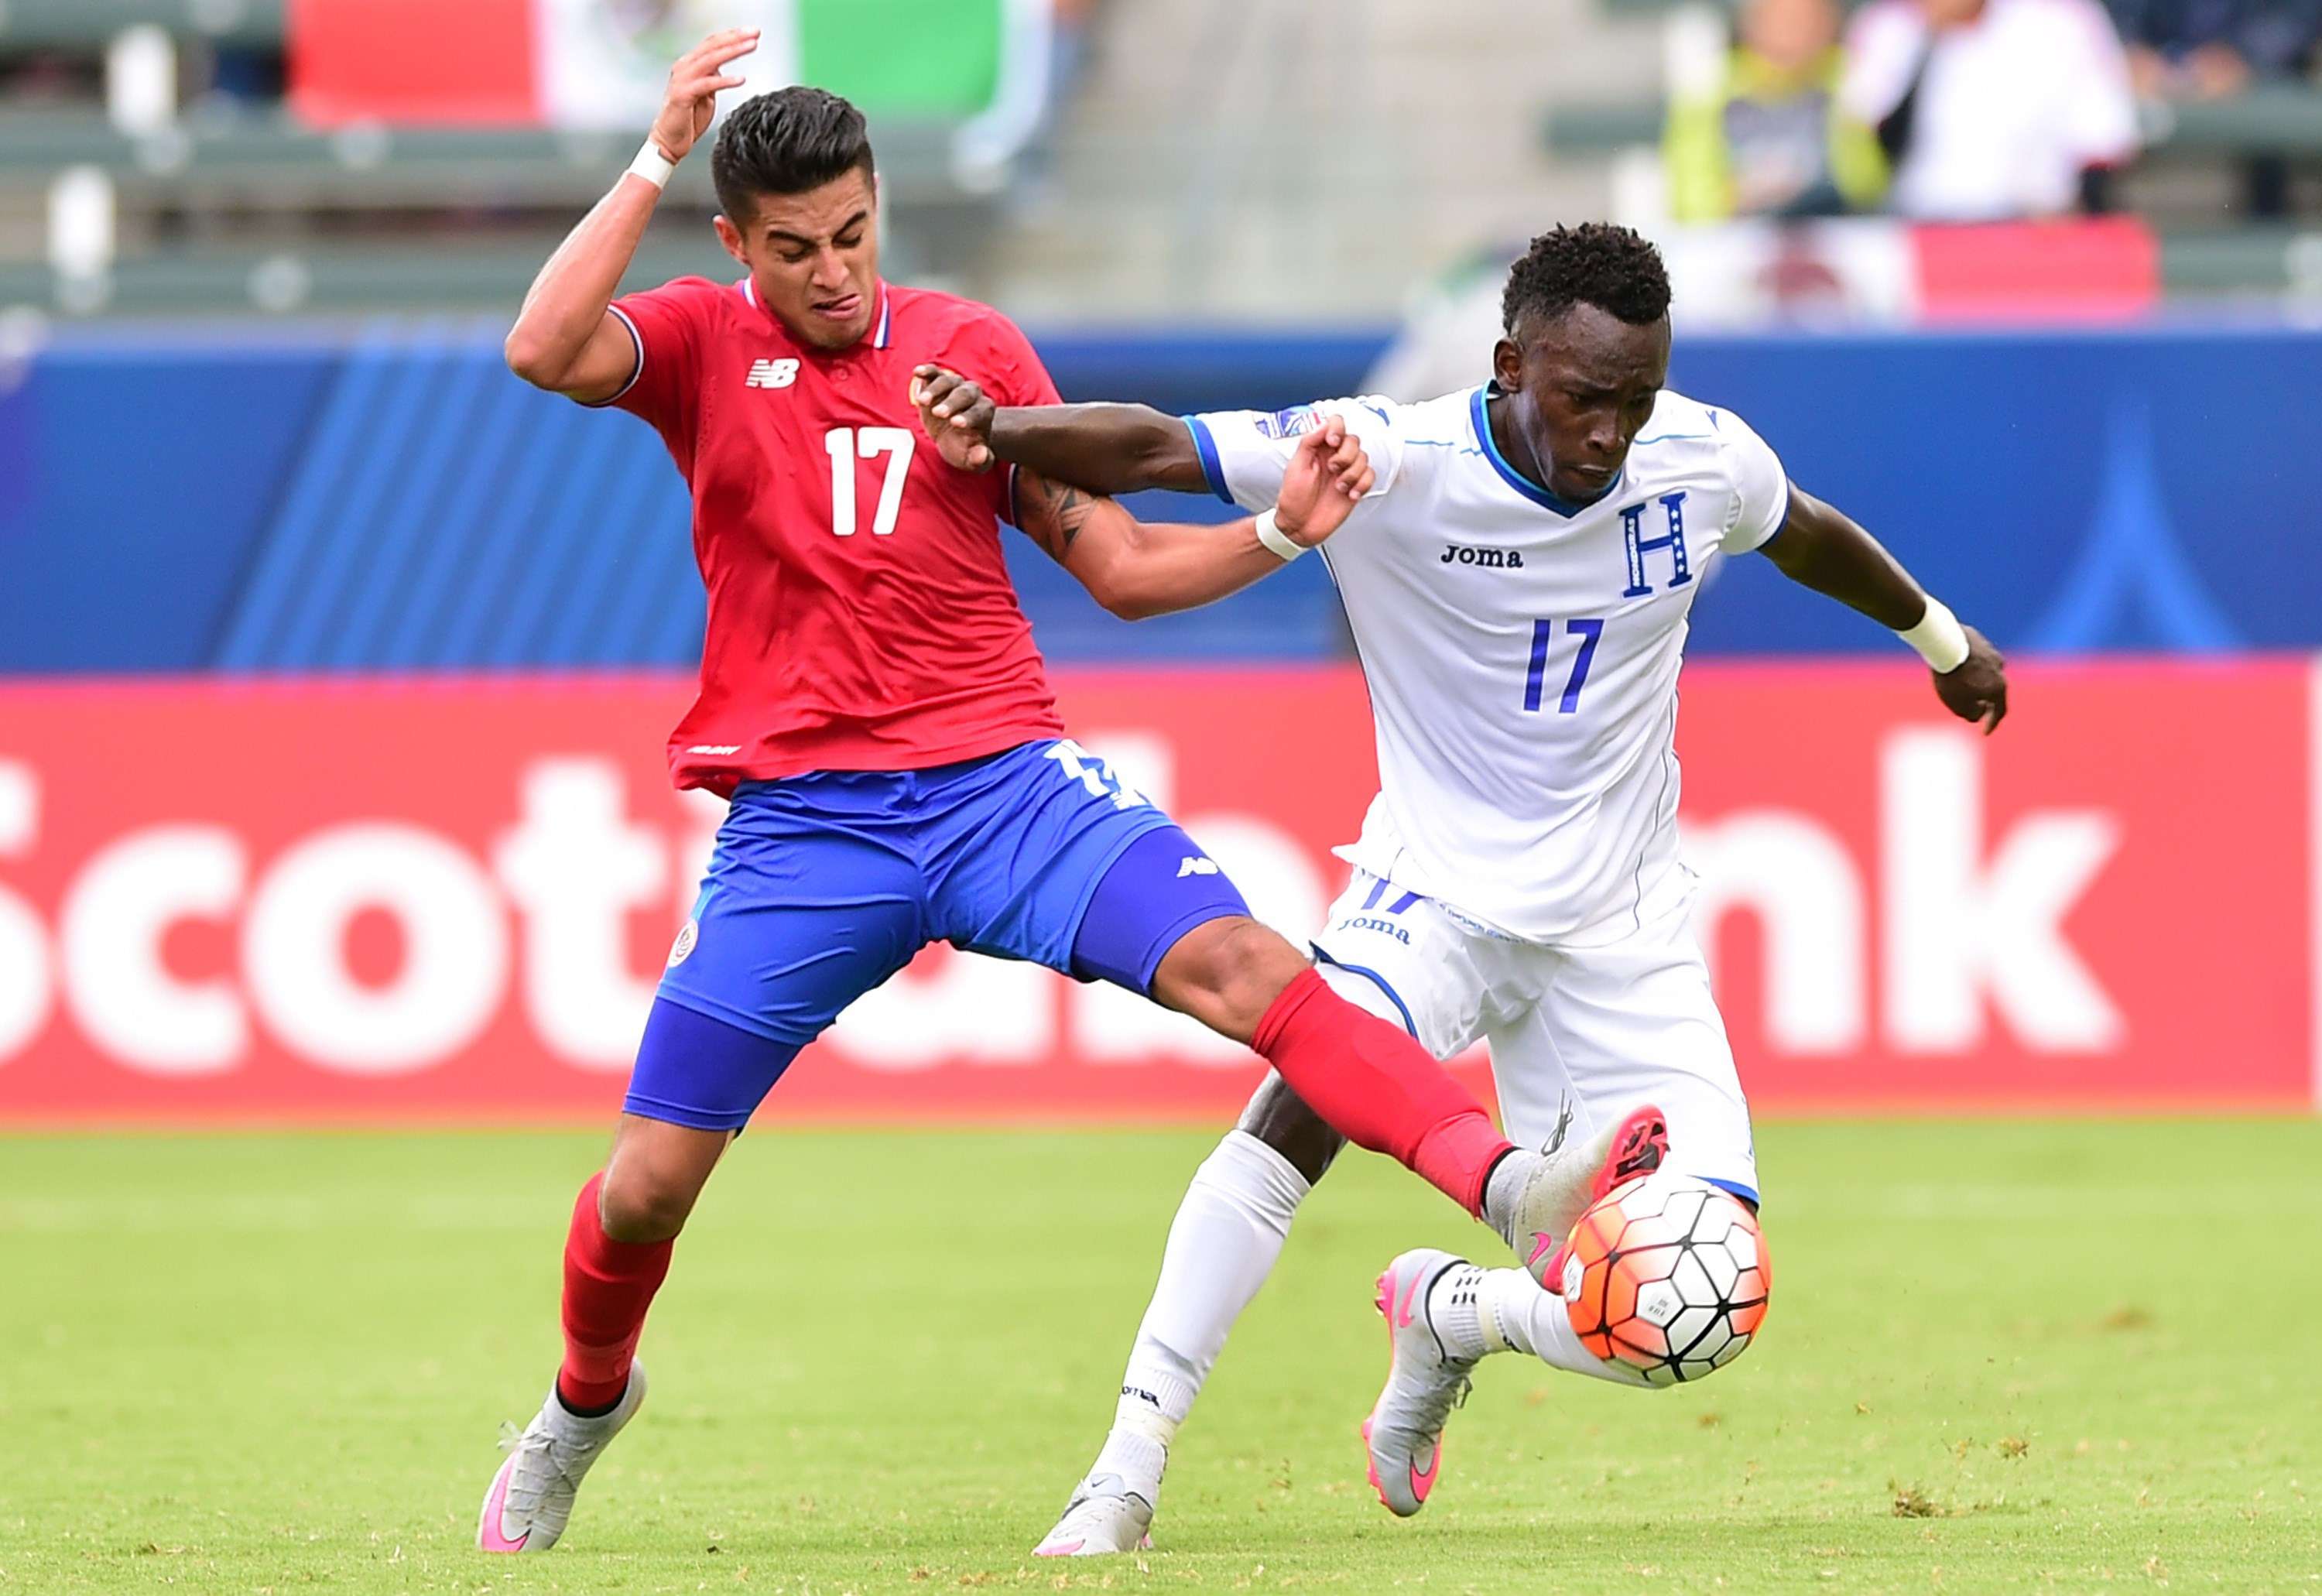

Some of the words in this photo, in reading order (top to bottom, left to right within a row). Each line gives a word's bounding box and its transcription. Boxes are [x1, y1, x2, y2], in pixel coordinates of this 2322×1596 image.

[824, 426, 916, 536] 17
[1440, 545, 1524, 568] Joma
[1523, 618, 1605, 714] 17
[0, 728, 2125, 1074] cotbnk
